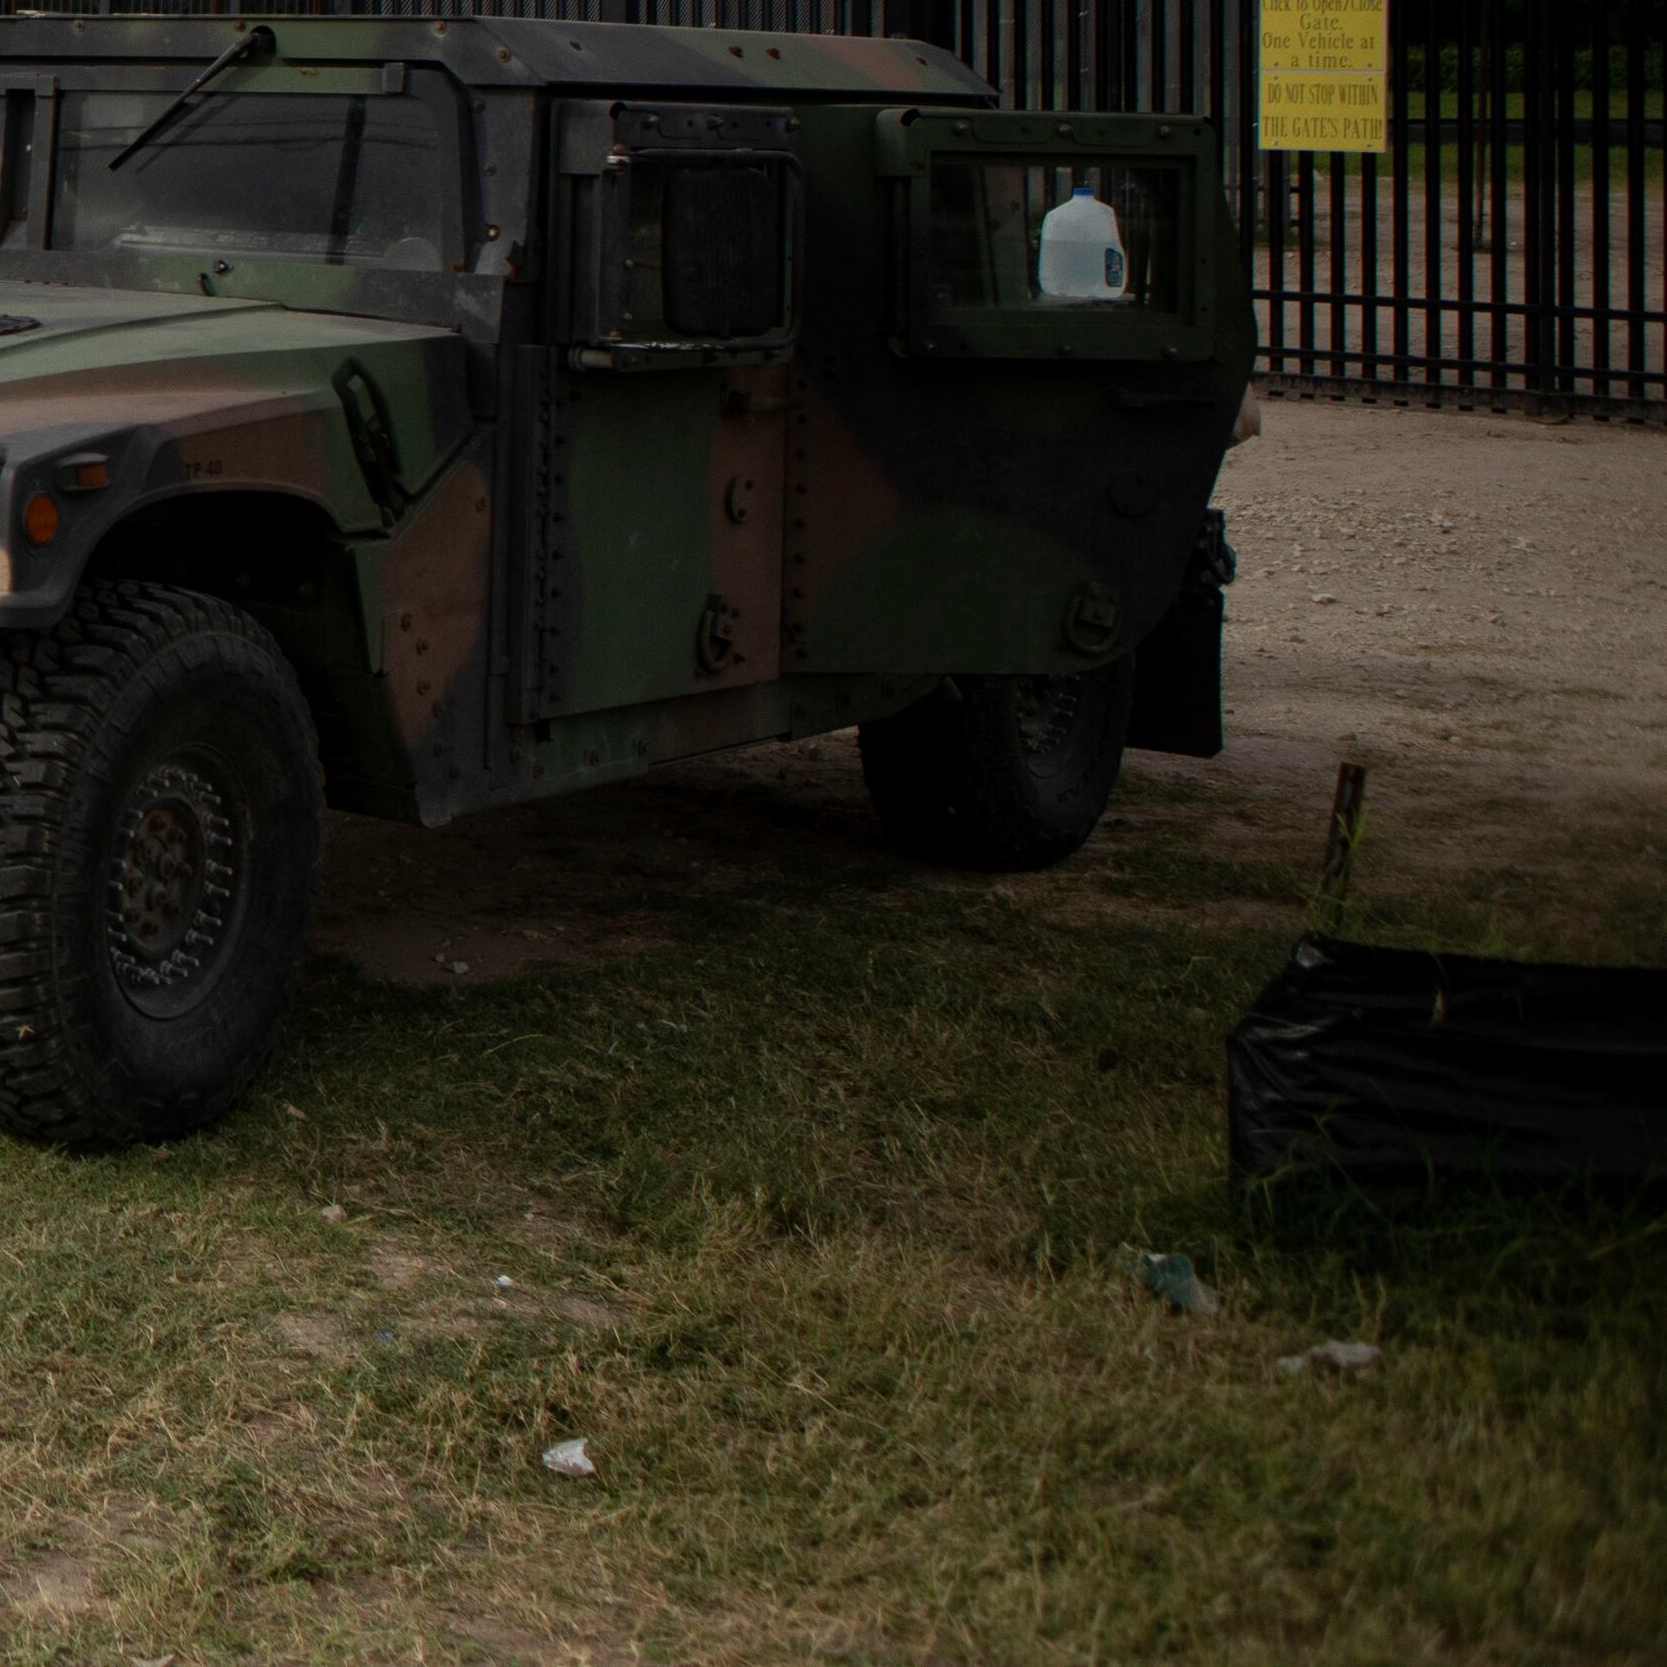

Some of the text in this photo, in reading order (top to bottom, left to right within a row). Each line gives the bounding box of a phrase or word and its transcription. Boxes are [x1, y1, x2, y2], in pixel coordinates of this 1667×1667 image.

[1300, 13, 1343, 30] Gate.
[1262, 32, 1375, 50] One Vehicle at
[1290, 51, 1353, 68] a time.
[1267, 83, 1378, 105] DO NOT STOP WITHIN
[1262, 116, 1383, 140] THE GATE'S PATH!
[186, 462, 202, 479] TP
